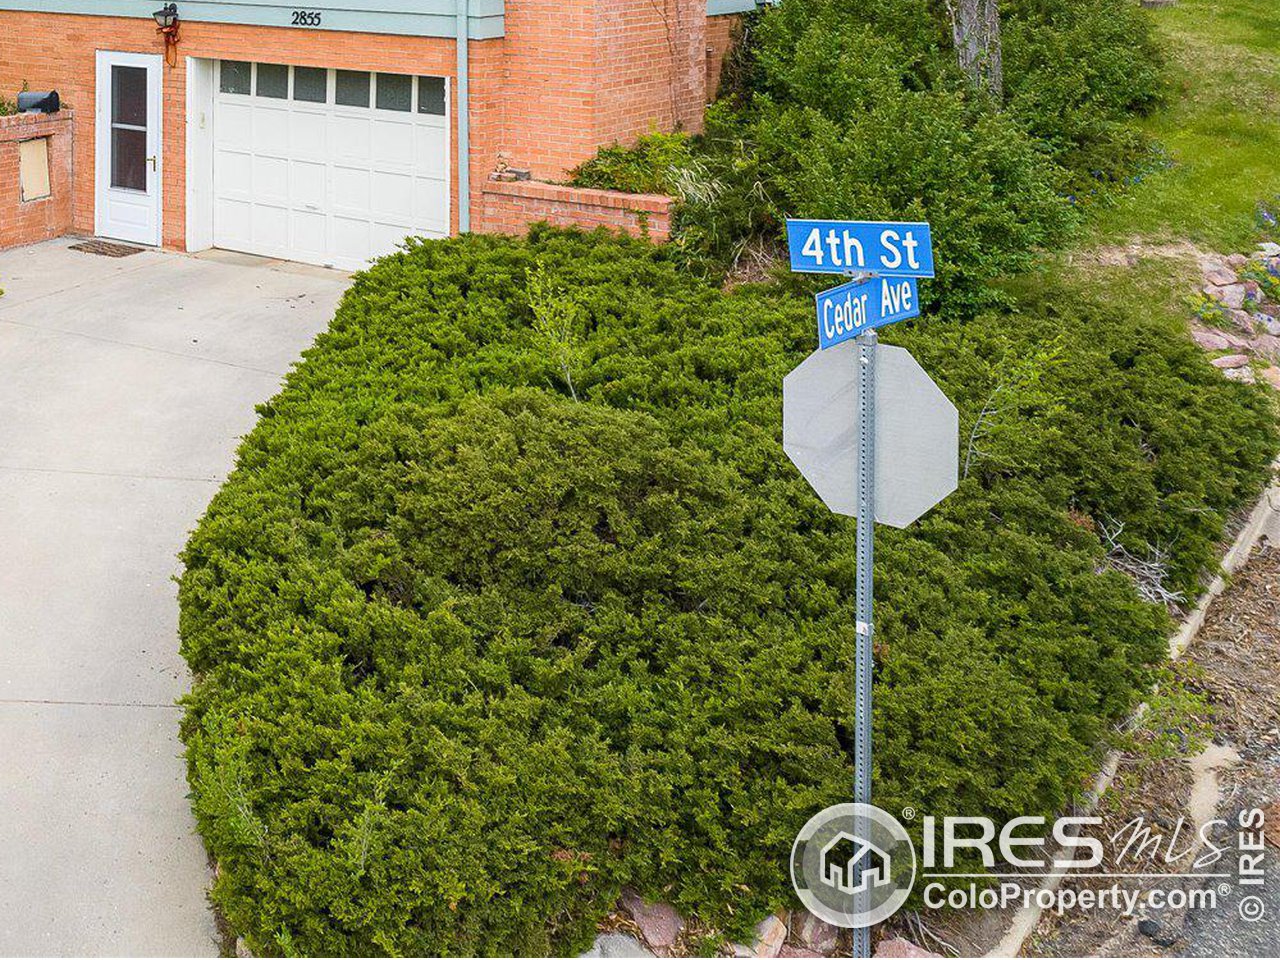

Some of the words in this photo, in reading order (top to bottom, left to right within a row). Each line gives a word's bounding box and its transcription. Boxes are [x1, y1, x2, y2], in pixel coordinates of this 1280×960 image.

[291, 10, 321, 26] 2855
[801, 228, 865, 267] 4th
[879, 229, 920, 270] St
[823, 292, 868, 339] Cedar
[881, 278, 912, 317] Ave
